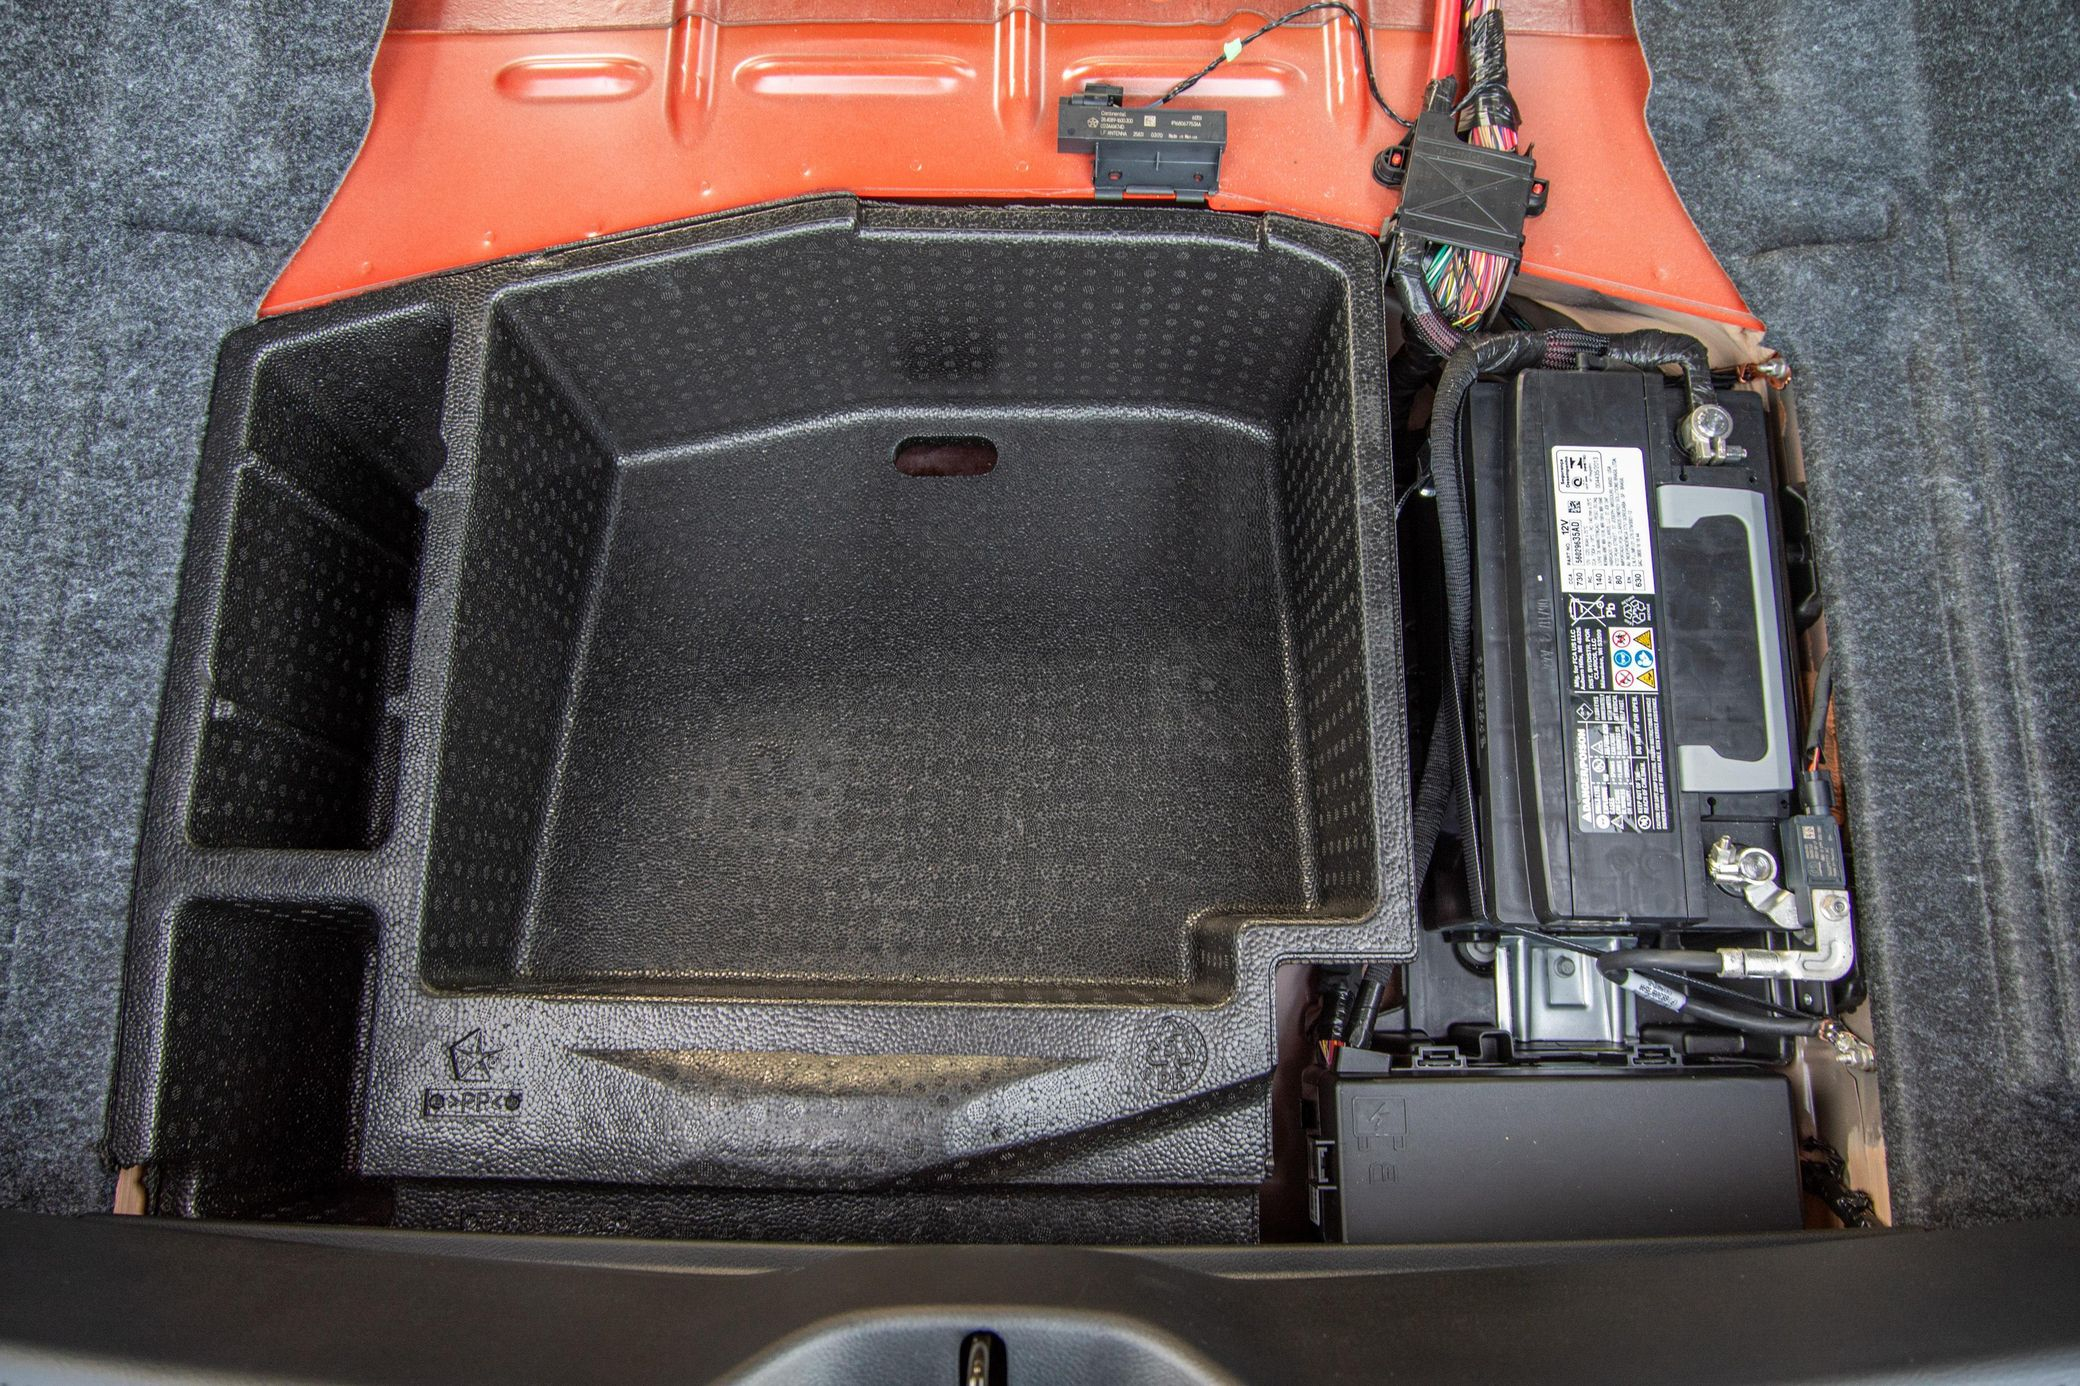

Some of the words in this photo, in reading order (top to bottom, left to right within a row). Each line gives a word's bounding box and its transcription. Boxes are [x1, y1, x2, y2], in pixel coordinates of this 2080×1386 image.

[1100, 110, 1127, 118] Continental
[1561, 519, 1569, 535] 12V
[1595, 573, 1603, 586] 140
[1615, 575, 1622, 585] 80
[1634, 573, 1642, 588] 630
[1606, 603, 1616, 618] Pb
[1571, 642, 1577, 651] US
[1633, 713, 1639, 722] OR
[1636, 746, 1642, 755] DO
[1577, 728, 1591, 812] DANGER/POISON
